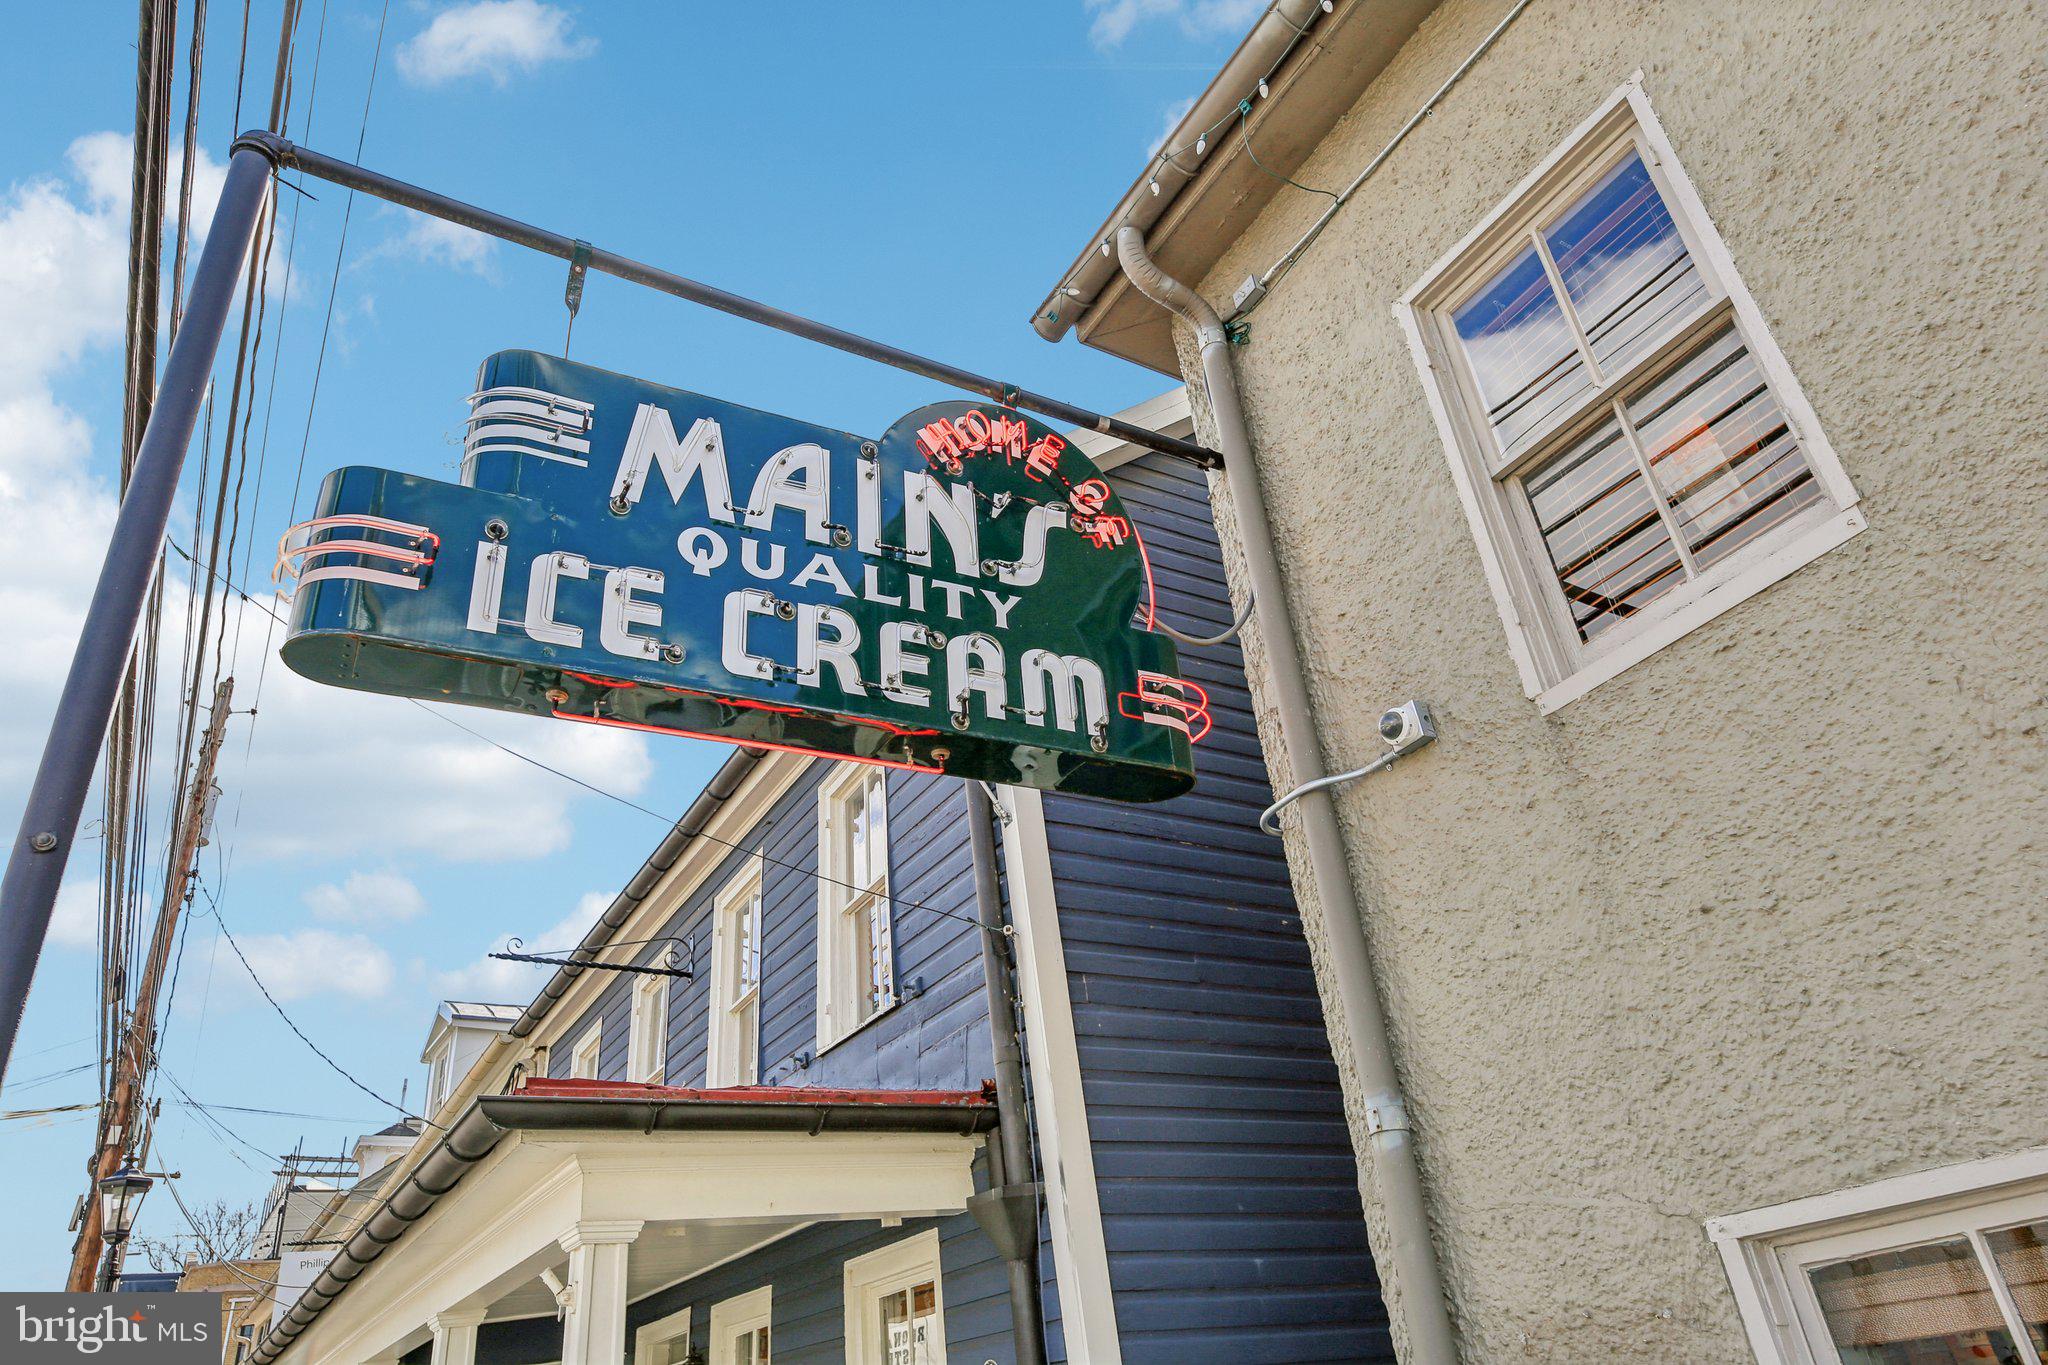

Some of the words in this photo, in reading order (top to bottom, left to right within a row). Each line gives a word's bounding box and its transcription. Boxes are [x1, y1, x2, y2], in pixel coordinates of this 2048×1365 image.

[610, 402, 1067, 587] MAIN'S
[916, 410, 1066, 482] HOME
[466, 540, 665, 662] ICE
[721, 587, 1109, 738] CREAM
[676, 526, 1022, 629] QUALITY
